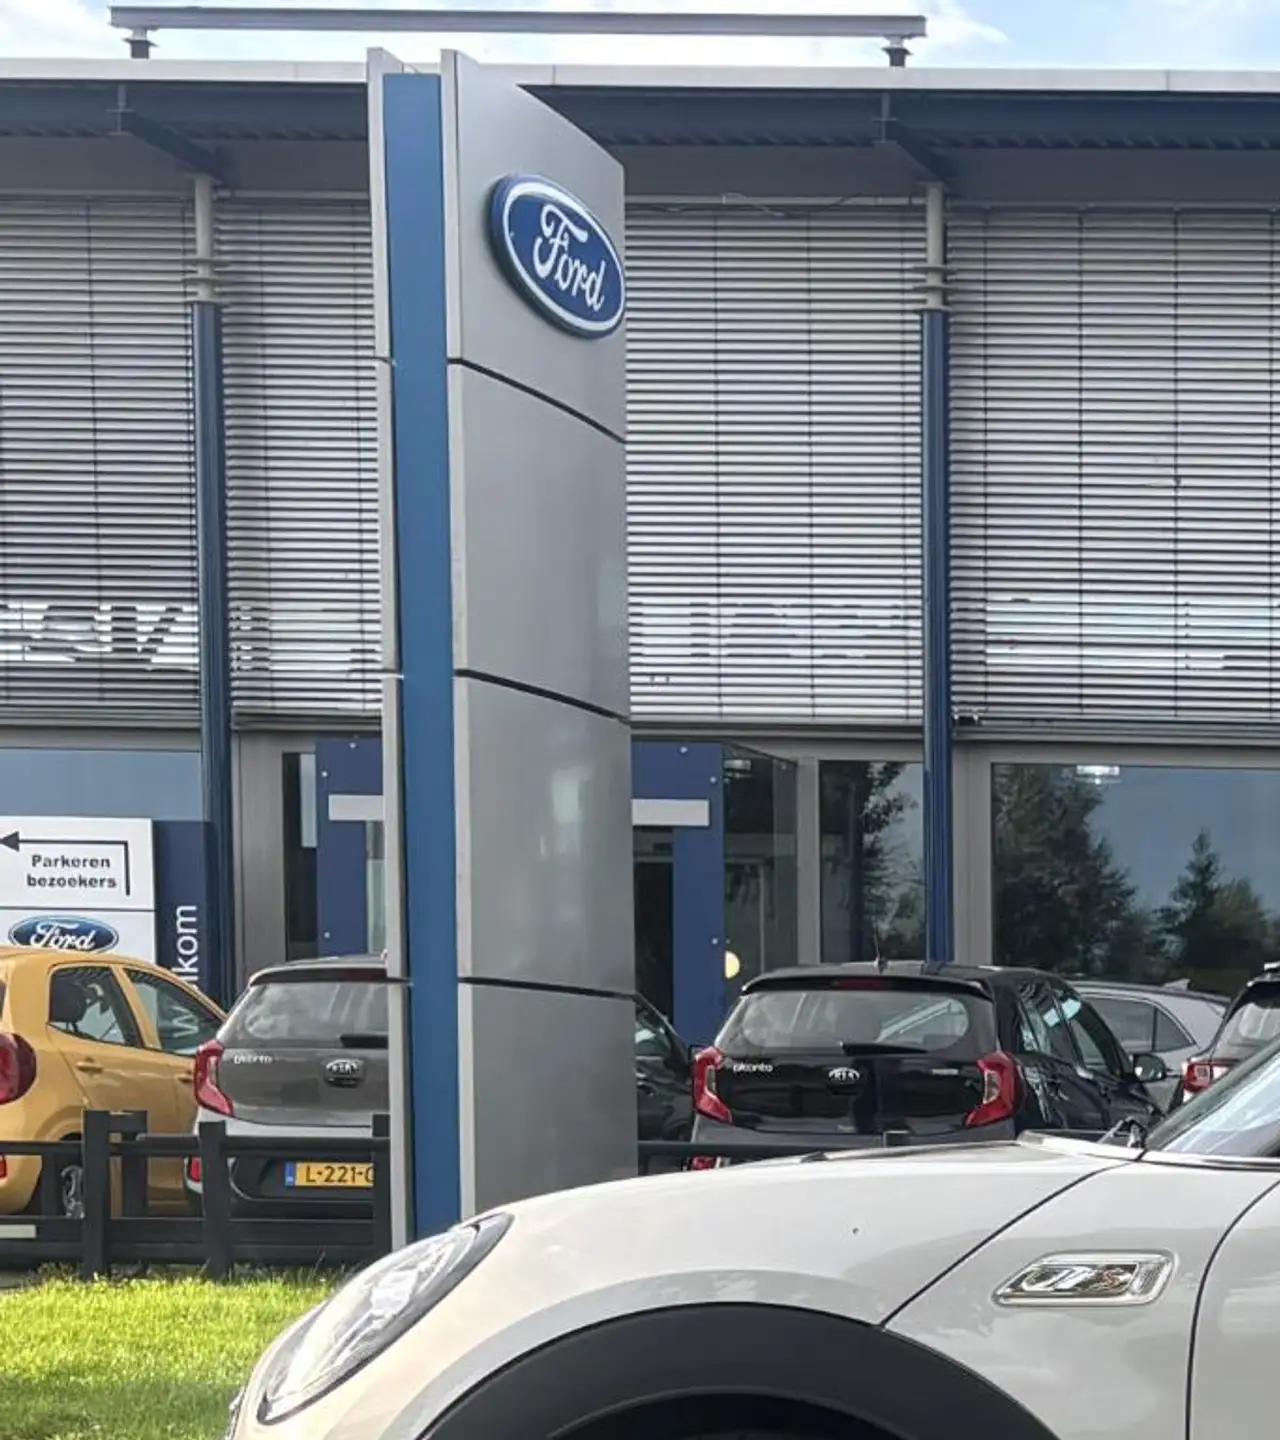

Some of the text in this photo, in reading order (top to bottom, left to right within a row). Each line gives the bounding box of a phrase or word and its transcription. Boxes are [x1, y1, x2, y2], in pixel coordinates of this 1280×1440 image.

[533, 203, 606, 311] Ford
[31, 854, 111, 868] Parkeren
[26, 874, 117, 889] bezoekers
[30, 921, 95, 950] Ford
